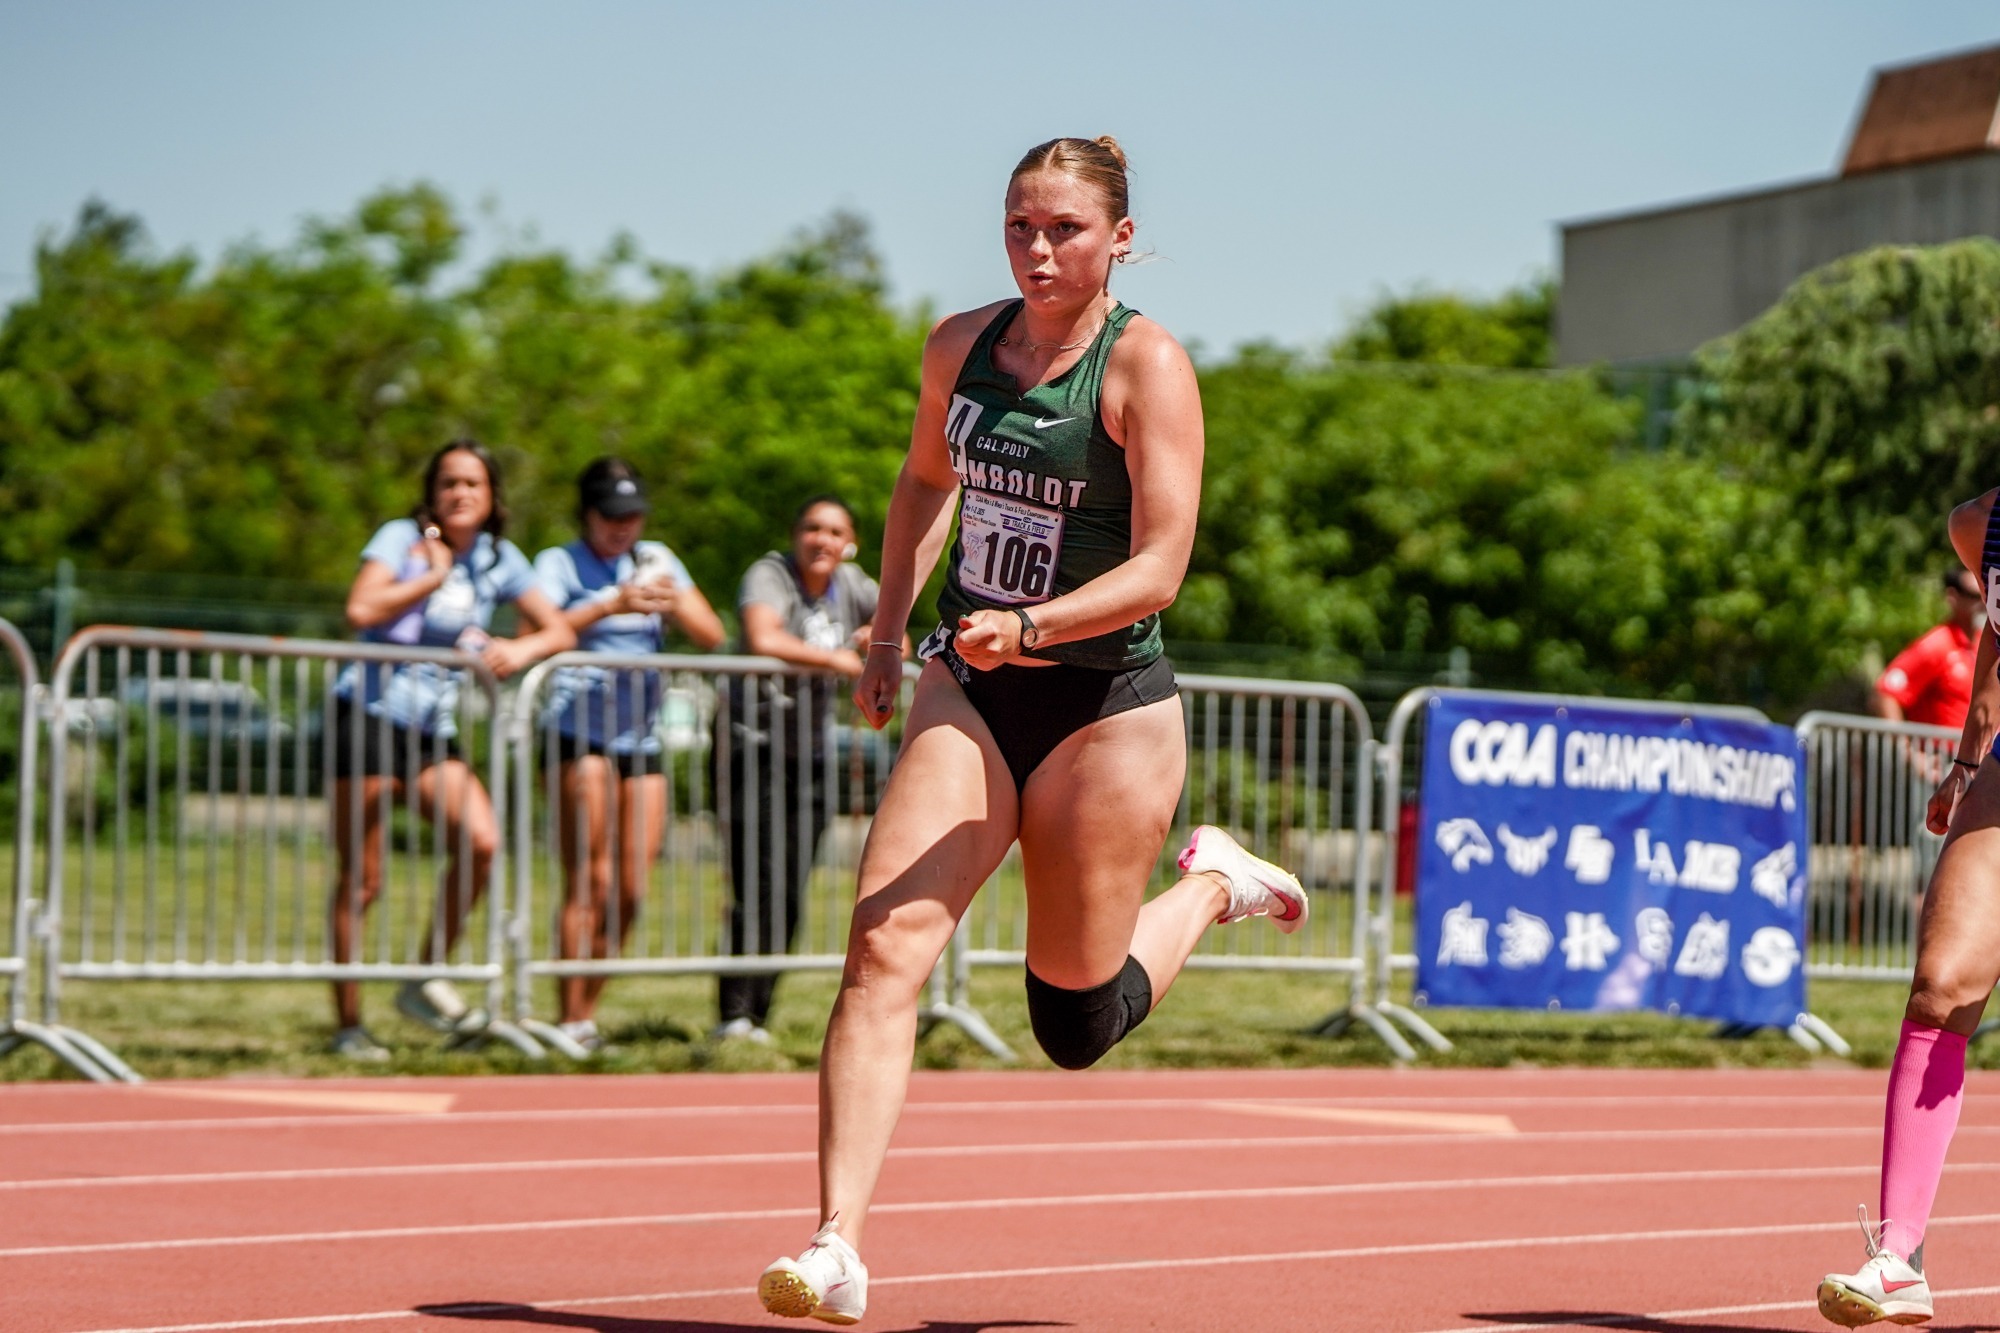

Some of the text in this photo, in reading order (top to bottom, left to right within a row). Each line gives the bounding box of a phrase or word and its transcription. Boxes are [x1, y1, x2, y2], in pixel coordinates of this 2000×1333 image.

[976, 436, 1030, 459] CAL POLY
[961, 459, 1087, 508] MBOLDT
[1011, 519, 1026, 530] TRACK
[1031, 525, 1046, 535] FIELD
[983, 532, 1052, 597] 106
[1450, 719, 1557, 788] CCAA
